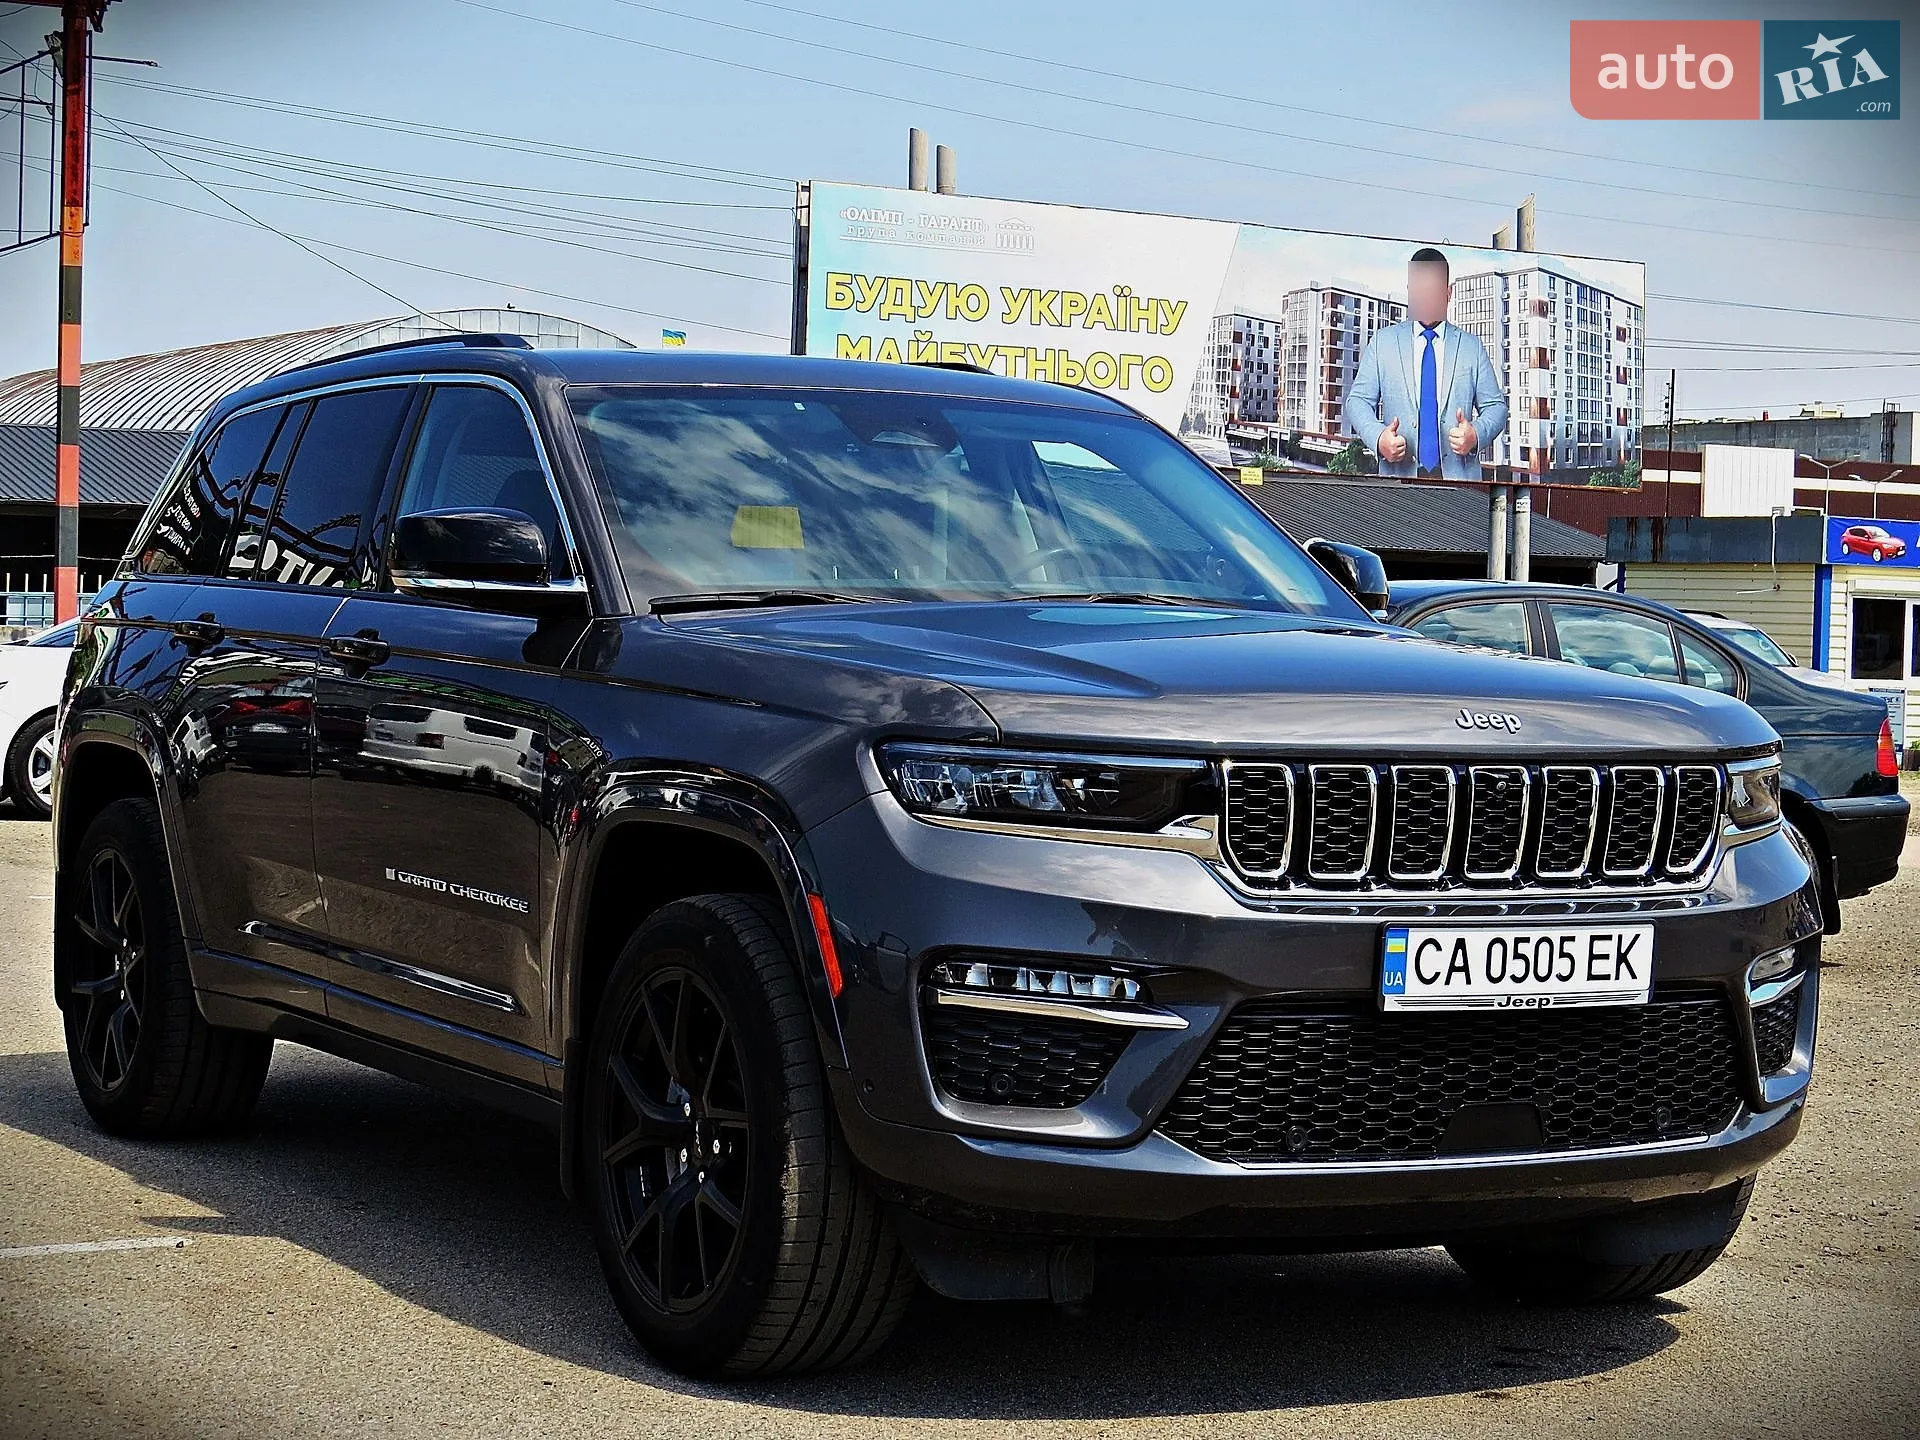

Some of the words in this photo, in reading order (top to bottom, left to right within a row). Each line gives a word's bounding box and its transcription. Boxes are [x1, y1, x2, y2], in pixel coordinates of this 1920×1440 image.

[847, 225, 897, 239] група
[905, 231, 985, 247] компаній
[826, 271, 989, 323] БУДУЮ
[1000, 284, 1188, 336] УКРАЇНУ
[1455, 707, 1522, 735] Jeep
[398, 871, 447, 892] GRAND
[449, 883, 529, 914] CHEROKEE
[1414, 936, 1472, 986] CA
[1485, 935, 1577, 984] 0505
[1586, 933, 1641, 982] EK
[1384, 971, 1404, 987] UA
[1497, 995, 1551, 1009] Jeep
